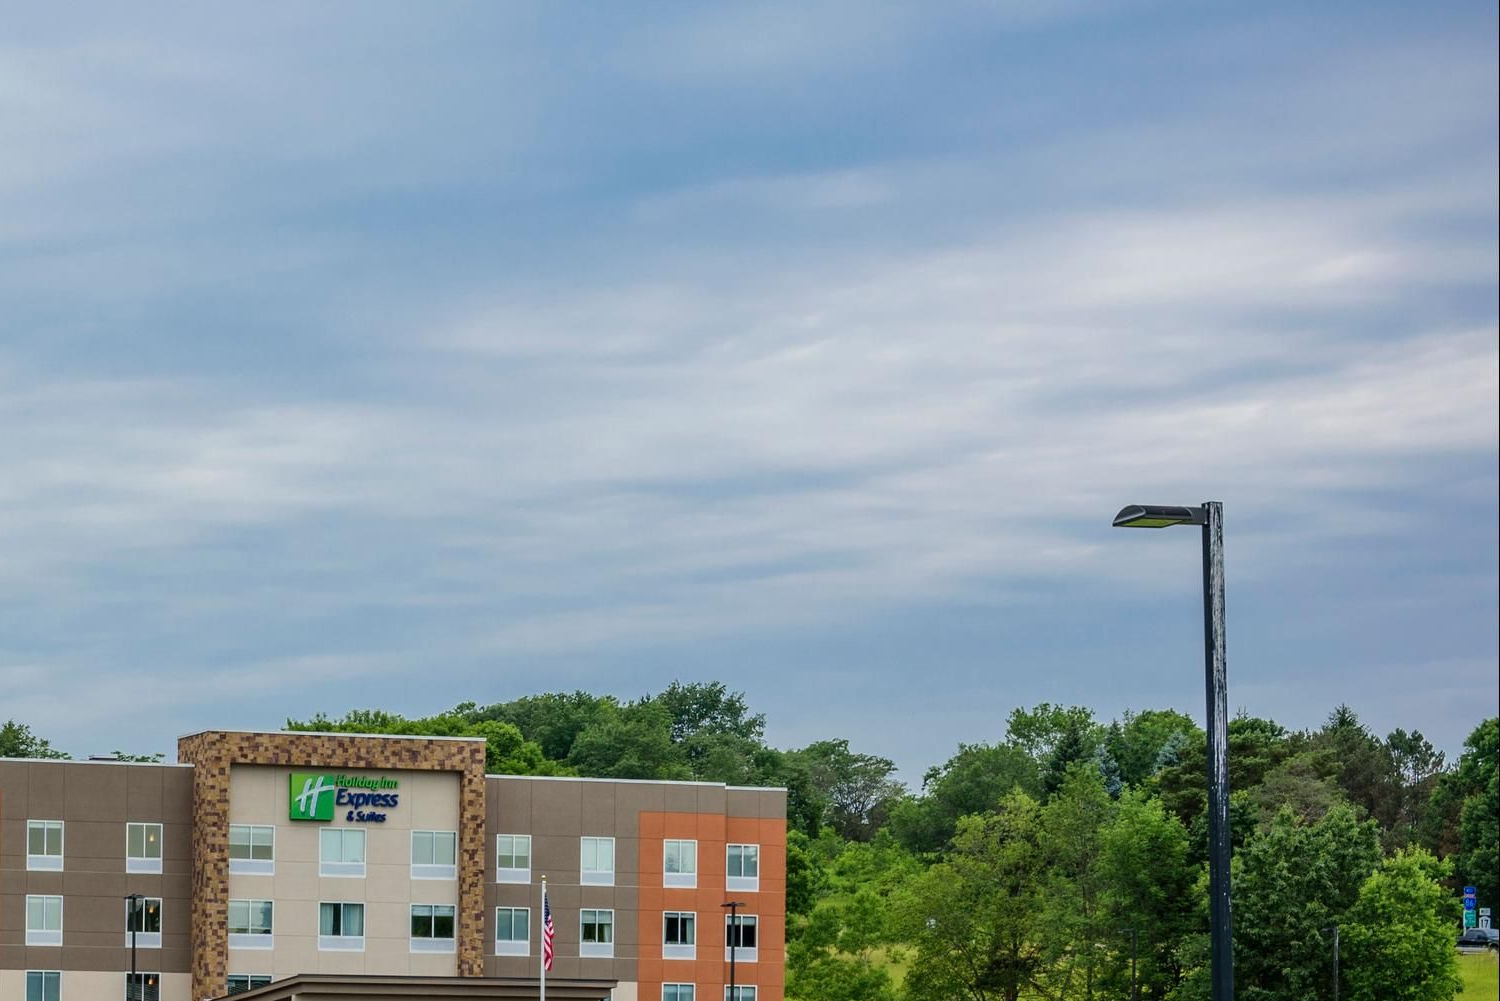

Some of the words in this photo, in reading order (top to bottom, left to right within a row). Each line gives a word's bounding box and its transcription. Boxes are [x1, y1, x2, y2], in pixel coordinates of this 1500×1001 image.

[336, 775, 380, 791] Holiday
[380, 776, 398, 789] Inn
[336, 788, 399, 809] Express
[346, 810, 354, 822] &
[356, 811, 387, 823] Suites
[1480, 919, 1489, 928] 17
